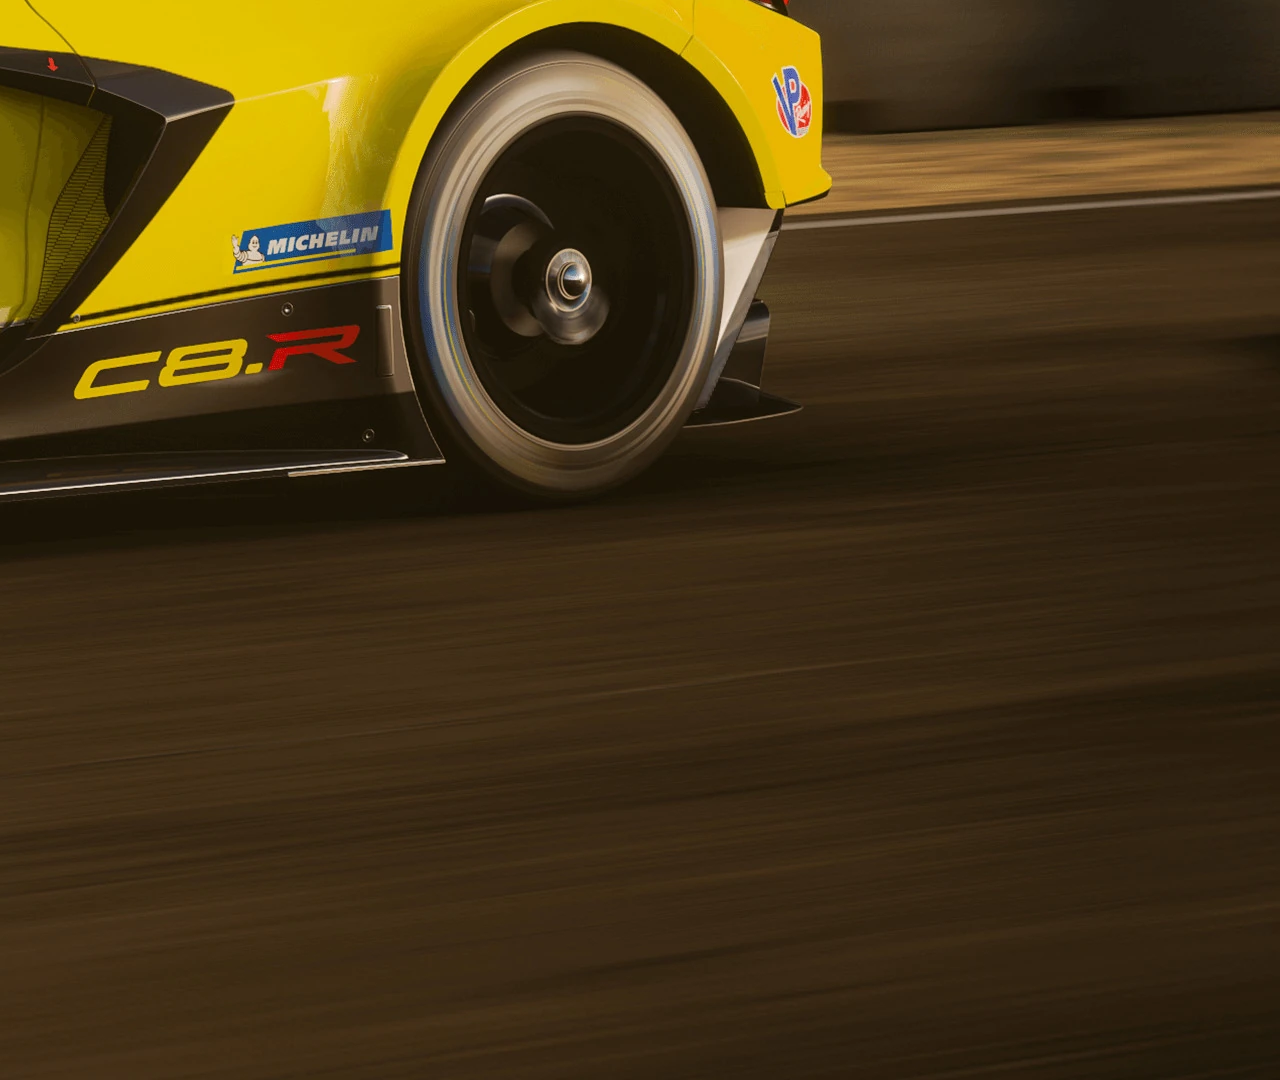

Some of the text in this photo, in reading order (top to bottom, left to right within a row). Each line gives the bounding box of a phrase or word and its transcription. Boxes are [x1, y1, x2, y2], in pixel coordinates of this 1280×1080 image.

[771, 65, 802, 137] VP
[266, 224, 379, 256] MICHELIN
[73, 324, 361, 400] C8.R
